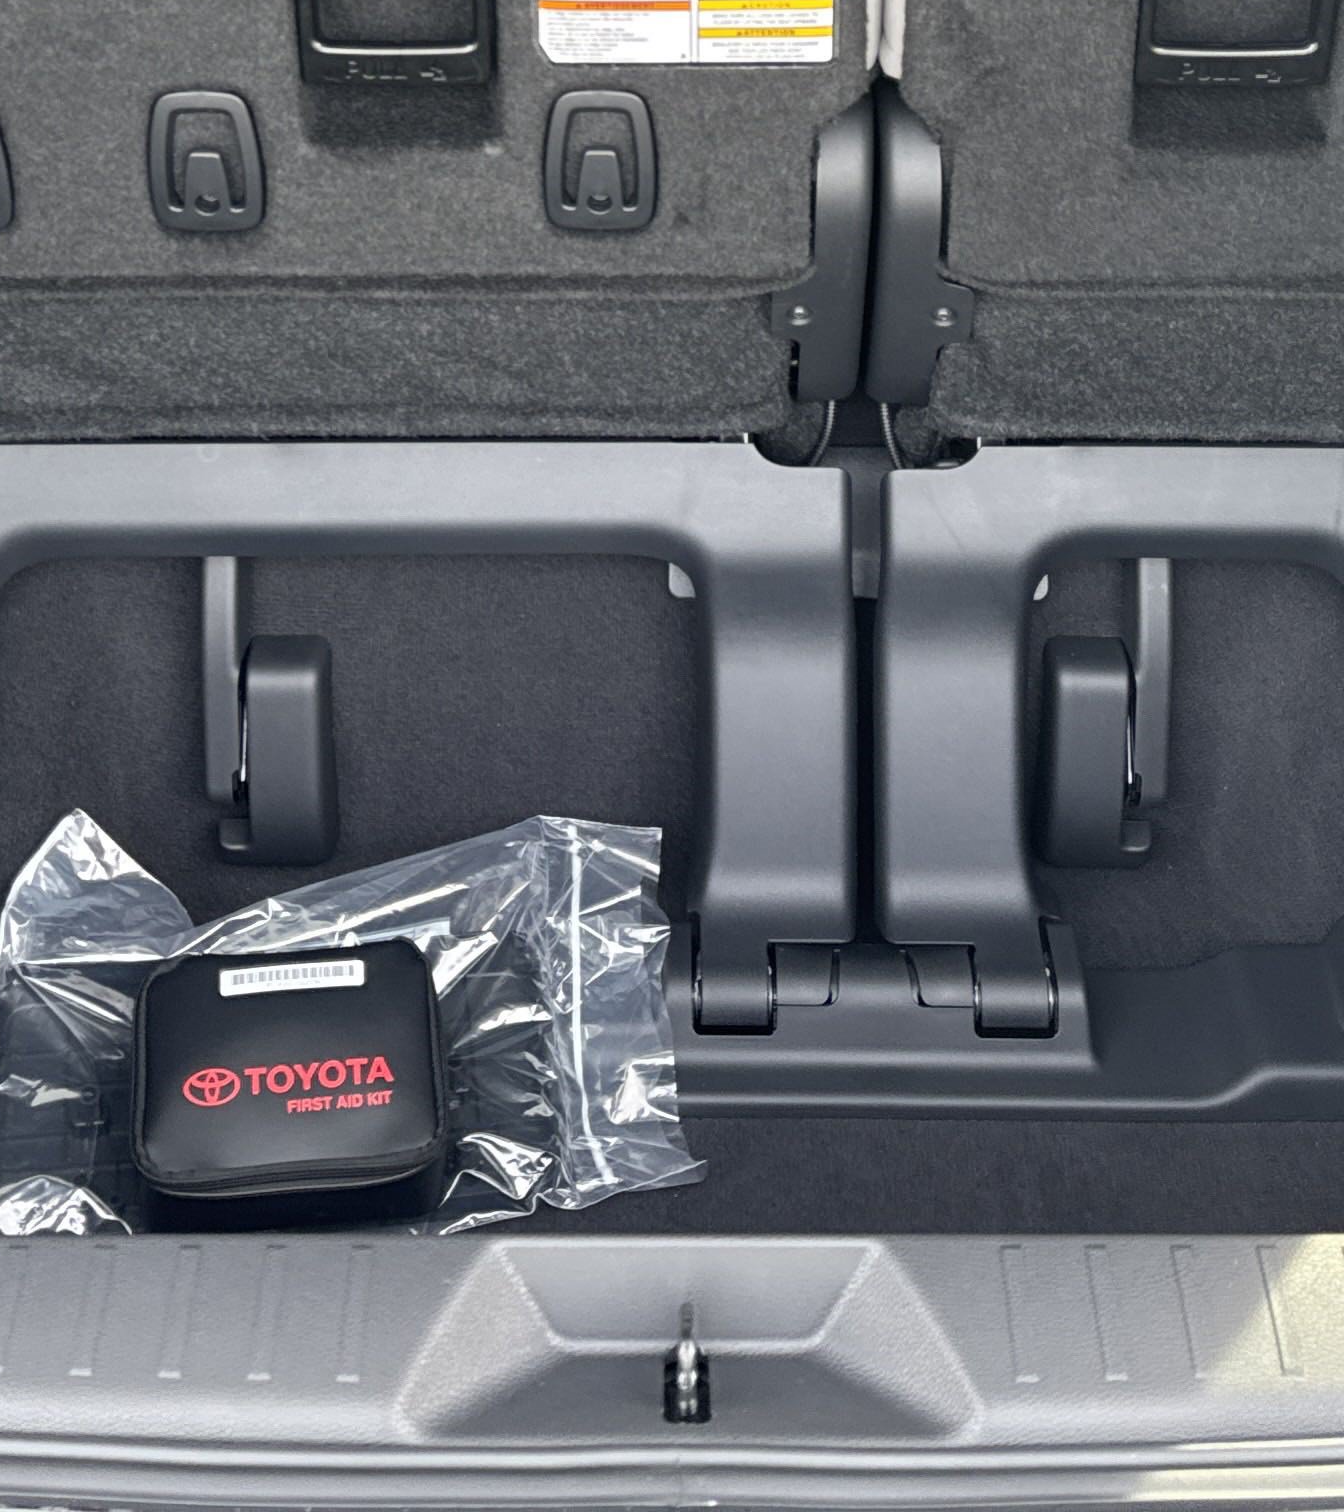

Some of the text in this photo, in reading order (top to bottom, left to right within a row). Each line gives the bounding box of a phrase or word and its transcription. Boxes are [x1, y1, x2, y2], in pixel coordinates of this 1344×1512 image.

[243, 1056, 395, 1096] TOYOTA
[286, 1090, 393, 1114] FIRST AID KIT
